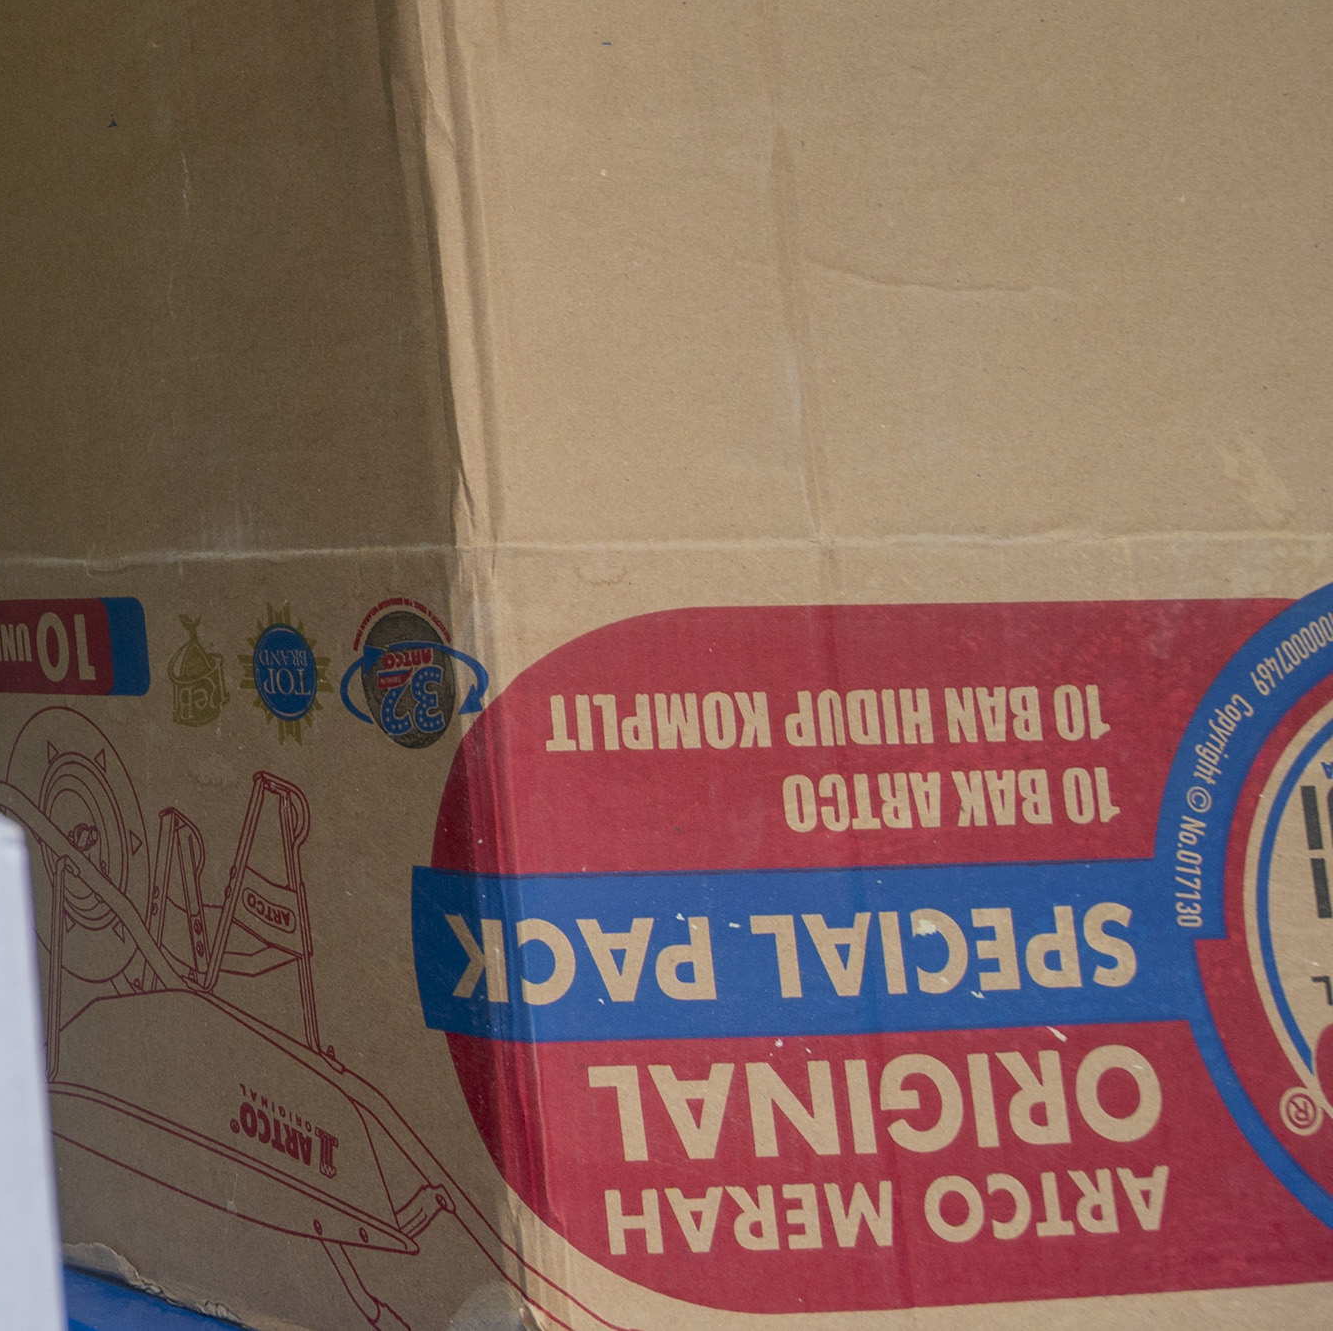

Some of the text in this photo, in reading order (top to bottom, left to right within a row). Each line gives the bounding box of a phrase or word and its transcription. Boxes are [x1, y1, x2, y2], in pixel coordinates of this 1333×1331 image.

[36, 611, 97, 683] 10
[258, 649, 308, 667] BRAND
[263, 667, 311, 695] TOP
[382, 648, 434, 670] ARTCO
[380, 665, 445, 736] 32
[545, 684, 1112, 752] 10 BAN HIDUP KOMPLIT
[1192, 692, 1254, 786] Copyright
[783, 766, 1121, 832] 10 BAK ARTCO
[1173, 814, 1207, 929] No.017130
[247, 893, 290, 927] ARTCO
[443, 901, 1137, 1005] SPECIAL PACK
[239, 1083, 312, 1133] ORIGINAL
[587, 1044, 1164, 1162] ORIGINAL
[604, 1165, 1170, 1256] ARTCO MERAH
